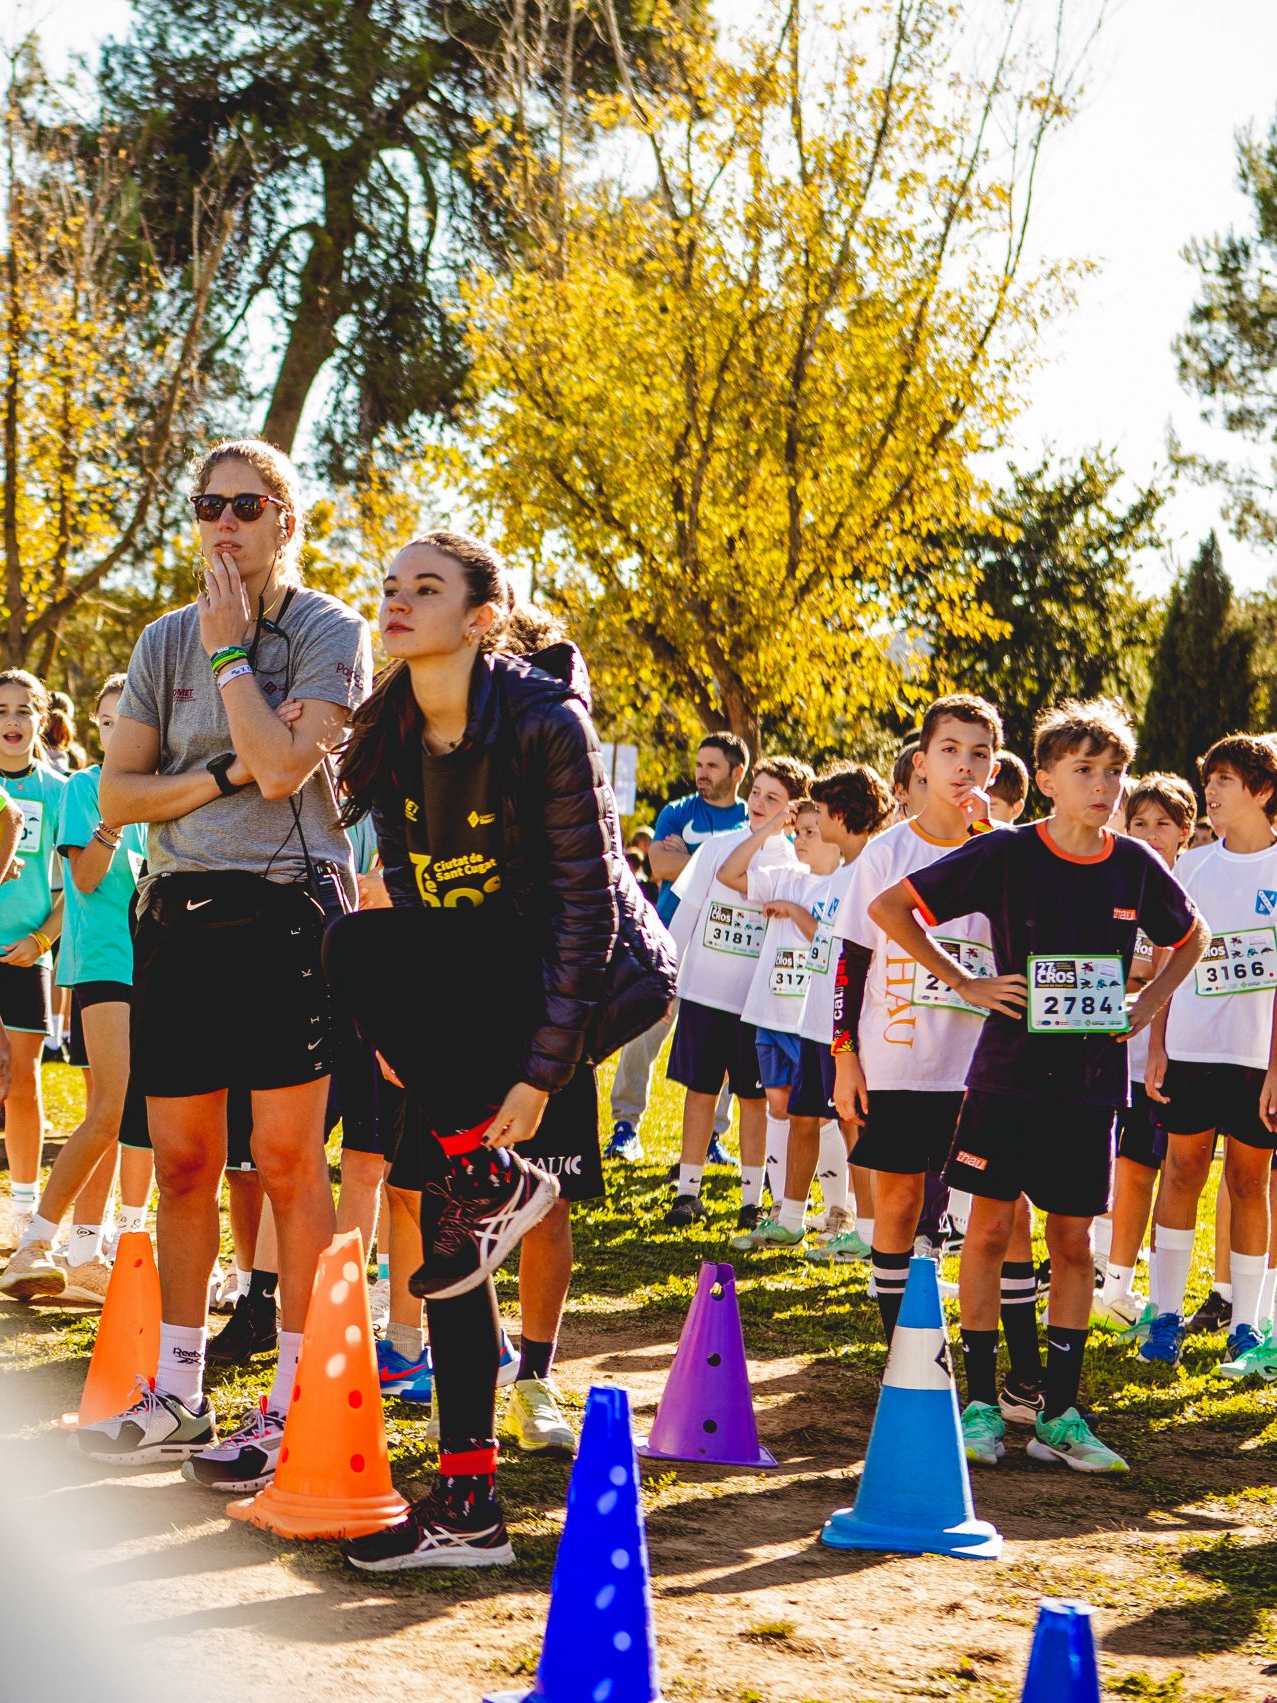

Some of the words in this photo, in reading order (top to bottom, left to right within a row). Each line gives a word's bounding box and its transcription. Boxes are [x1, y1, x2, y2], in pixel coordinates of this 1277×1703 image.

[433, 855, 469, 873] Ciutat
[469, 853, 484, 863] de
[435, 867, 465, 881] Sant
[464, 858, 497, 875] Cugat
[713, 928, 752, 946] 3181
[776, 973, 811, 985] 317
[1036, 971, 1075, 984] CROS
[1206, 961, 1265, 982] 3166
[883, 935, 917, 1049] HAU
[1044, 996, 1112, 1015] 2784
